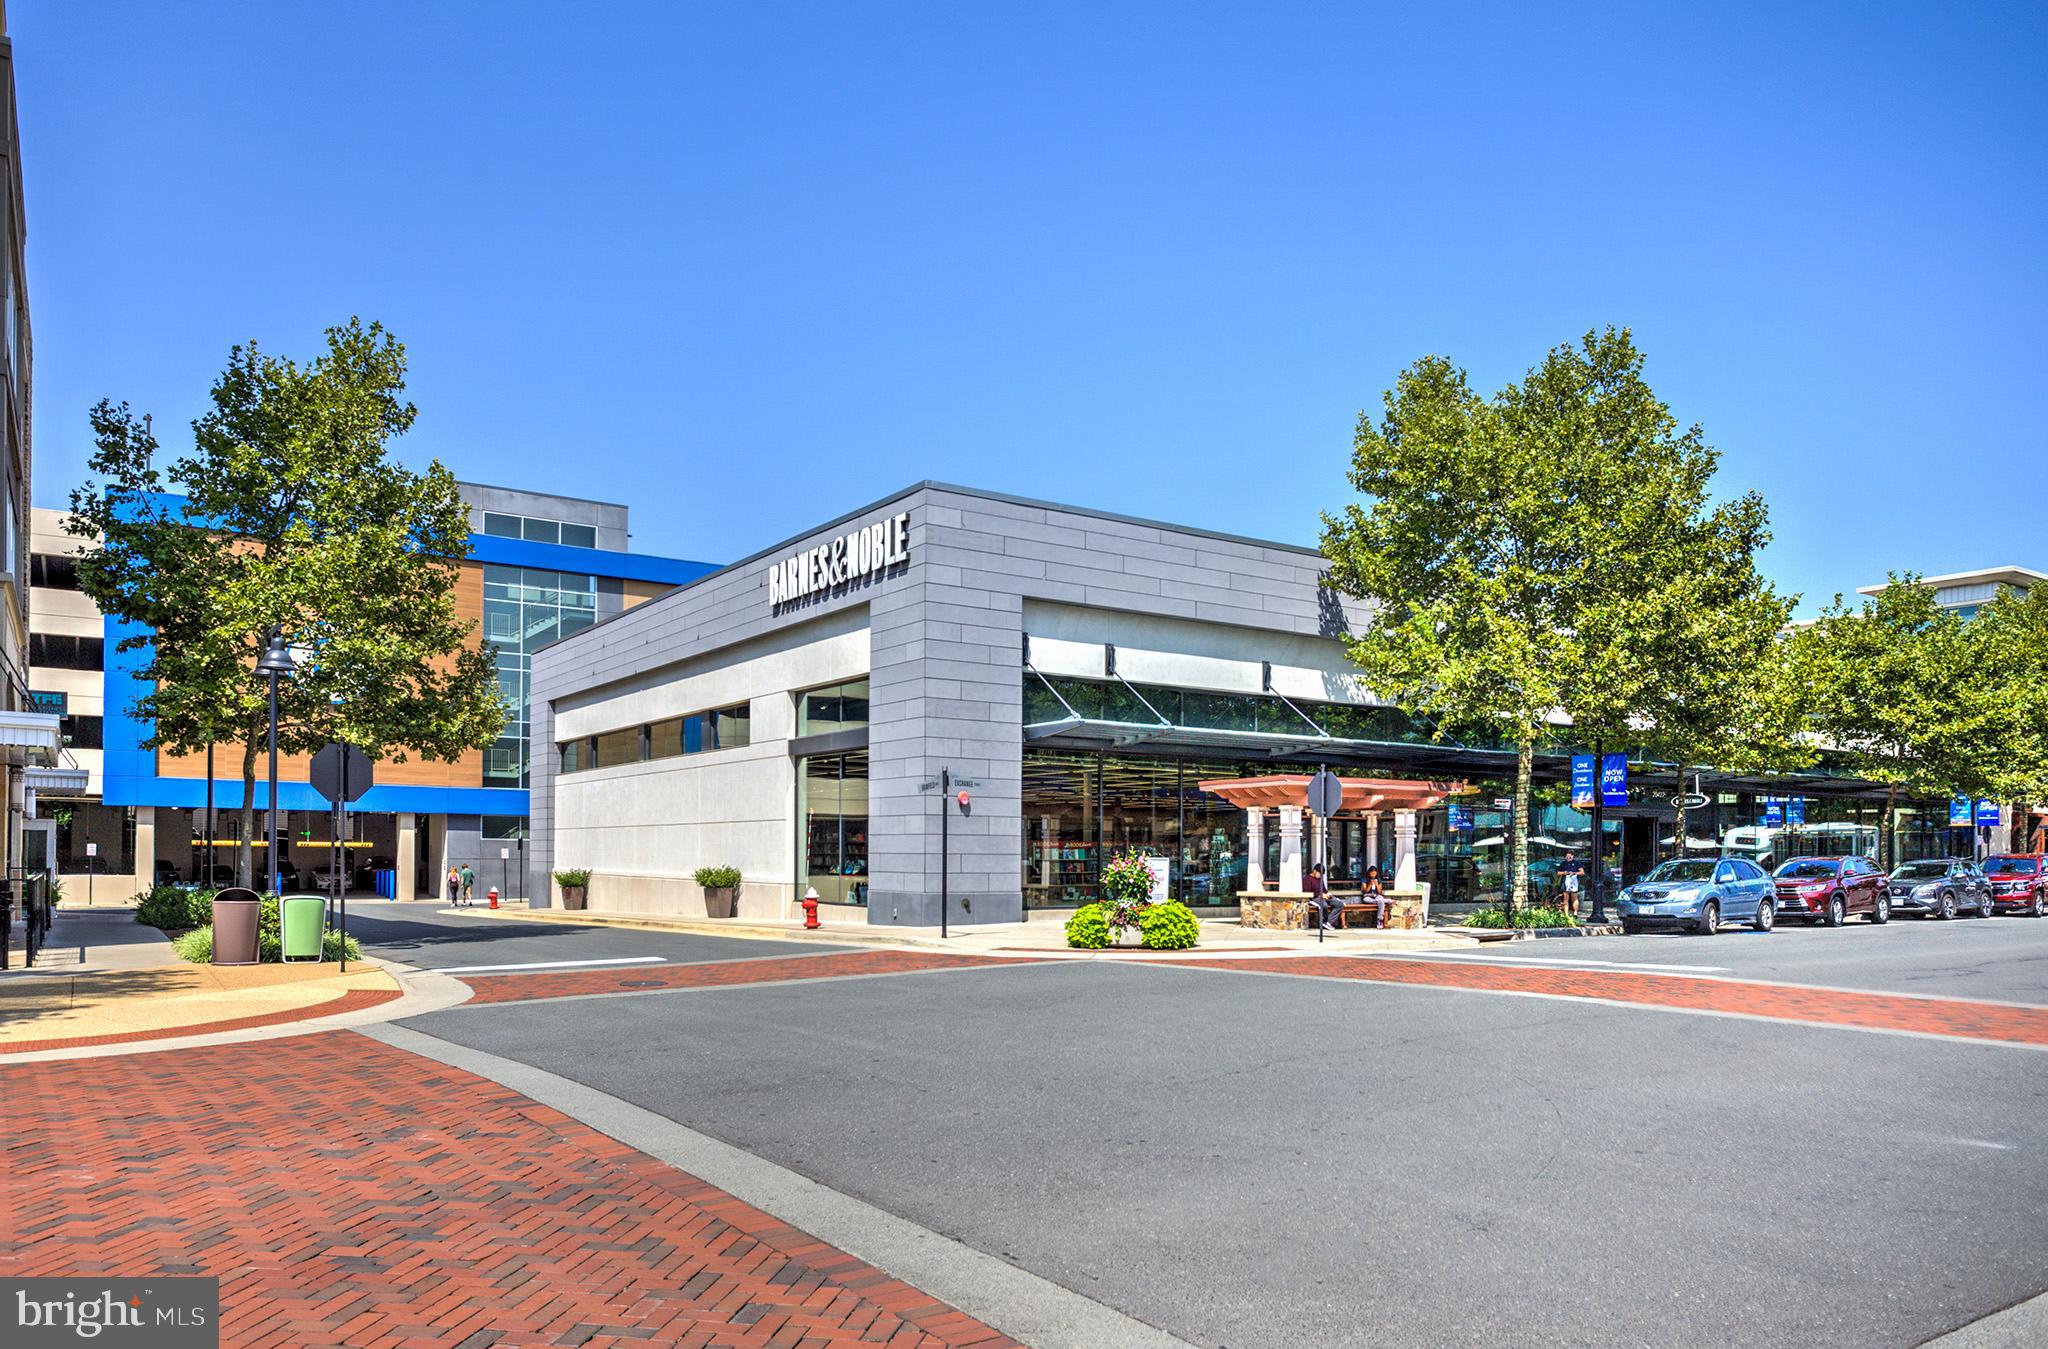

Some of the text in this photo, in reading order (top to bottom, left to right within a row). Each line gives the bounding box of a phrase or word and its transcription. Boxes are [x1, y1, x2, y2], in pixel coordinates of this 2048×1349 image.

[769, 511, 908, 606] BARNES & NOBLE
[1603, 775, 1624, 783] OPEN
